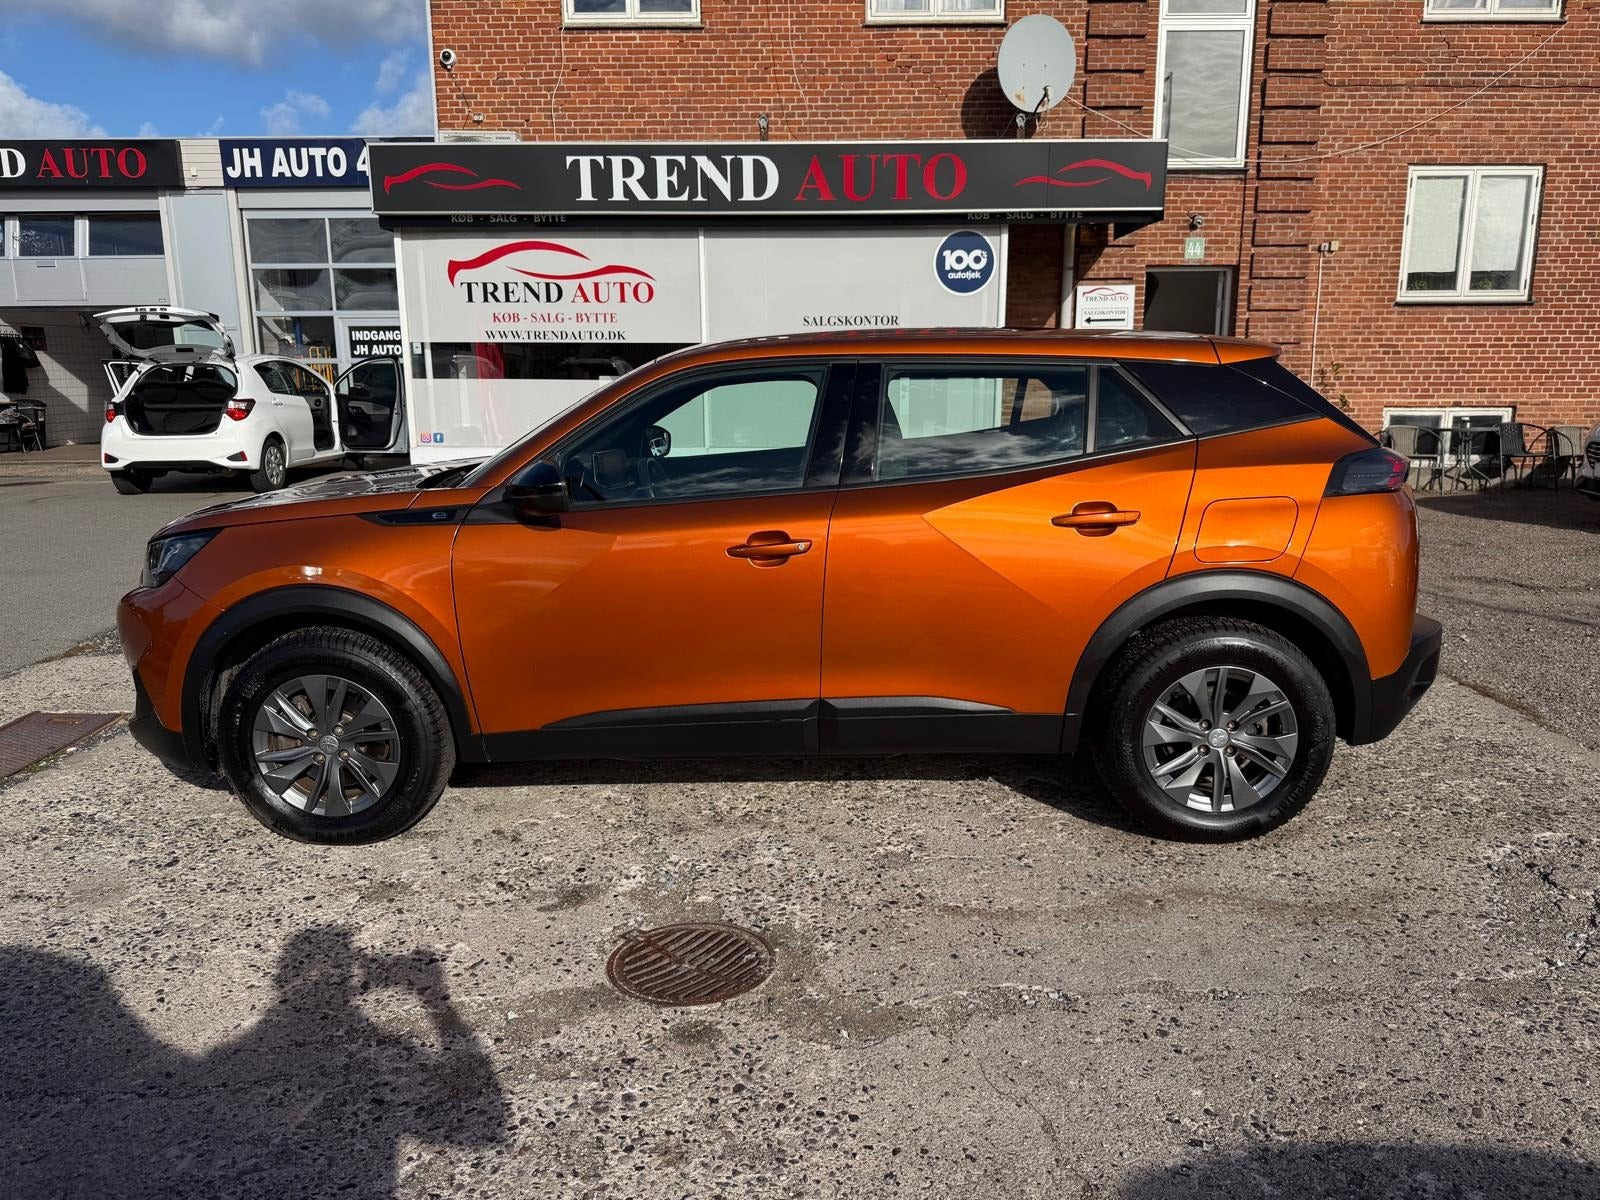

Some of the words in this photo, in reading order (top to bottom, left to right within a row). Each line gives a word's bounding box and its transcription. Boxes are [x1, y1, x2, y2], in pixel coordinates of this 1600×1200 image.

[36, 147, 147, 179] AUTO
[226, 147, 263, 178] JH
[271, 146, 347, 178] AUTO
[566, 154, 780, 202] TREND
[793, 152, 968, 201] AUTO
[489, 213, 518, 223] SALG
[533, 213, 567, 223] BYTTE
[1005, 211, 1034, 220] SALG
[1187, 241, 1201, 256] 44
[947, 270, 981, 280] autotjek
[460, 281, 564, 304] TREND
[570, 281, 655, 304] AUTO
[492, 312, 520, 323] KØB
[530, 312, 565, 323] SALG
[575, 312, 618, 323] BYTTE
[802, 315, 900, 327] SALGSKONTOR
[351, 330, 401, 341] INDGANG
[485, 330, 627, 341] WWW.TRENDAUTO.DK
[353, 344, 369, 356] JH
[371, 344, 402, 355] AUTO
